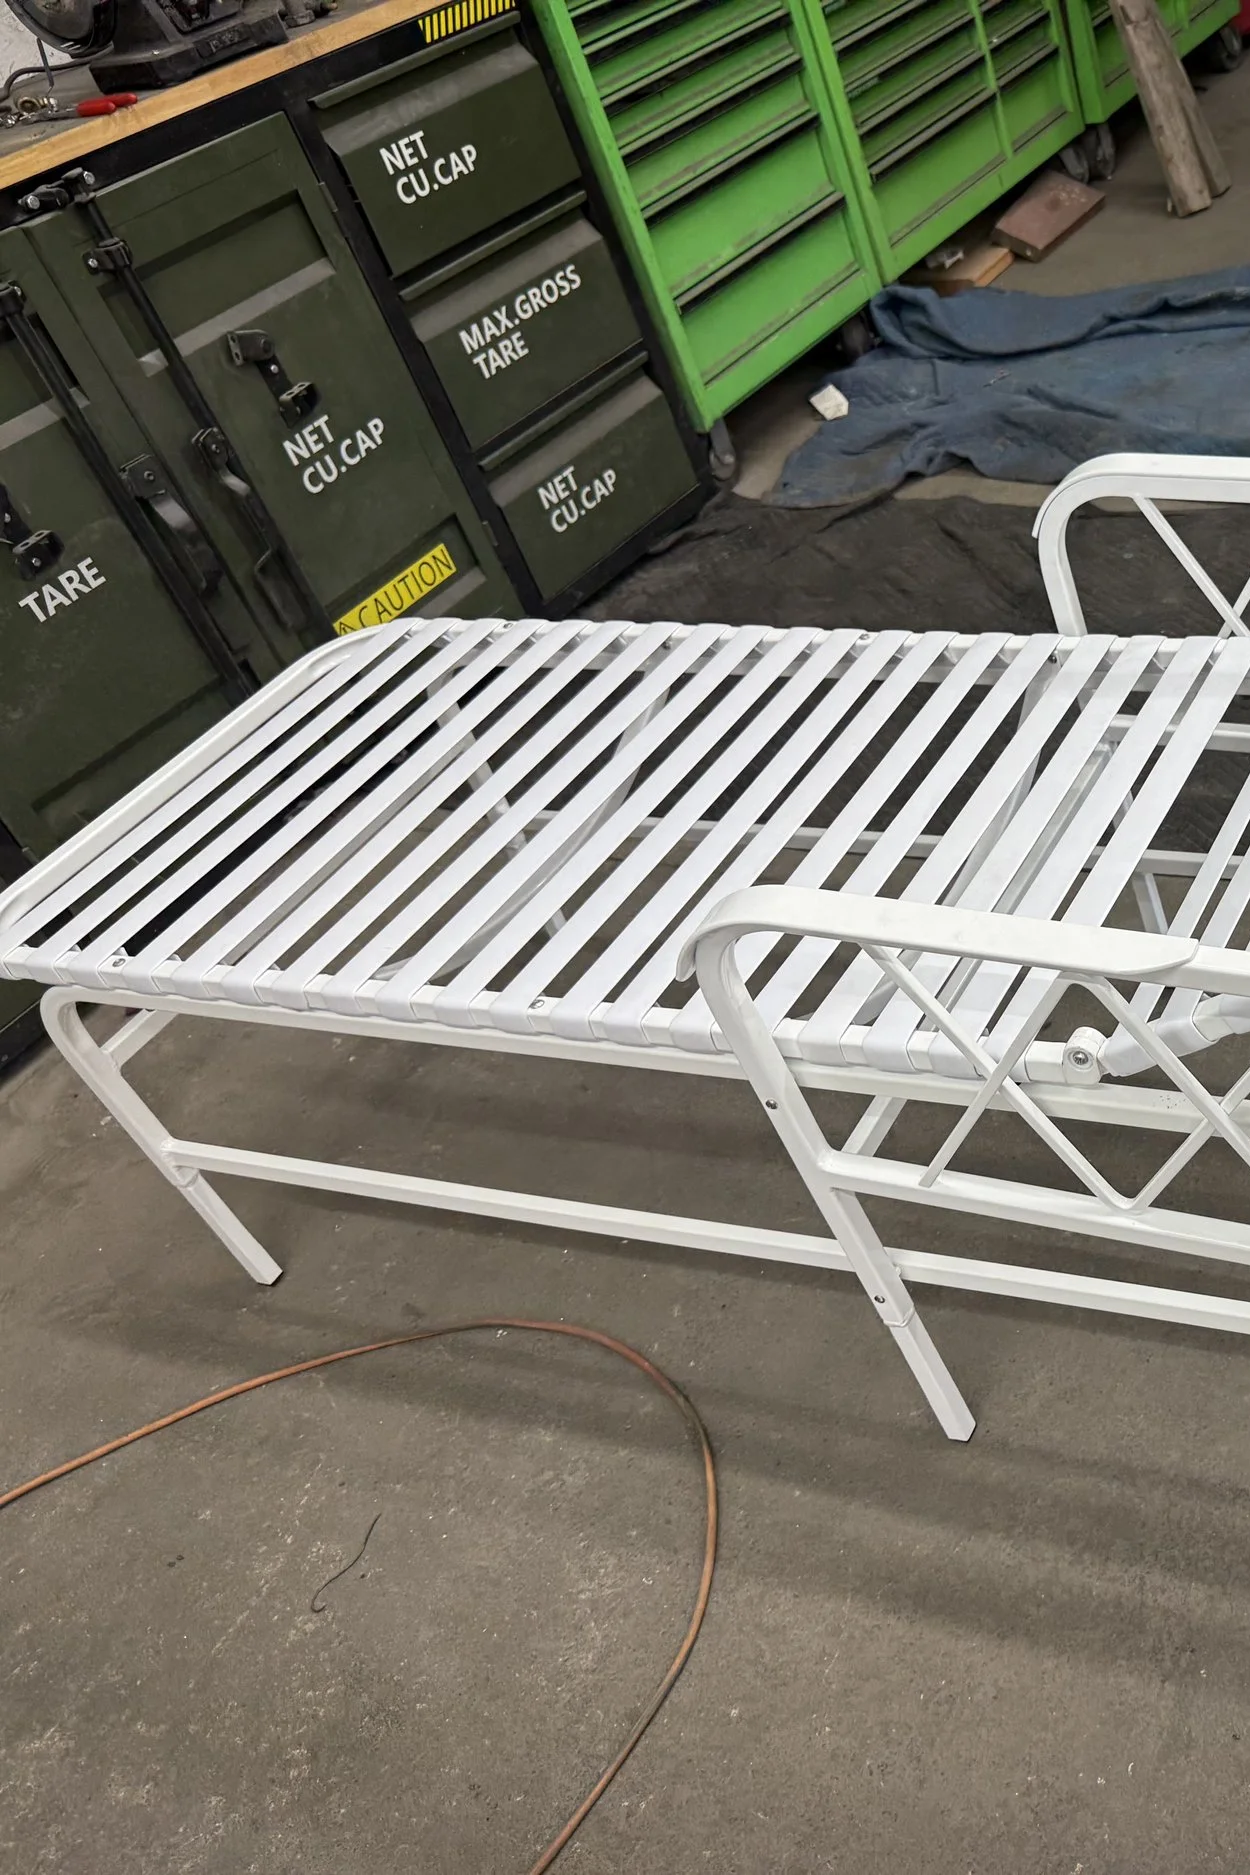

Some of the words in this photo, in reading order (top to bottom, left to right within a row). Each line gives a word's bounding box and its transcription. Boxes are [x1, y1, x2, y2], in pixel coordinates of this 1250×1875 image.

[380, 131, 428, 175] NET
[397, 145, 477, 203] CU.CAP
[459, 265, 581, 354] MAX.GROSS
[473, 332, 529, 378] TARE
[283, 415, 334, 465] NET
[303, 418, 384, 493] CU.CAP
[538, 466, 578, 509] NET
[552, 470, 616, 532] CU.CAP
[19, 557, 106, 622] TARE
[358, 548, 454, 628] CAUTION
